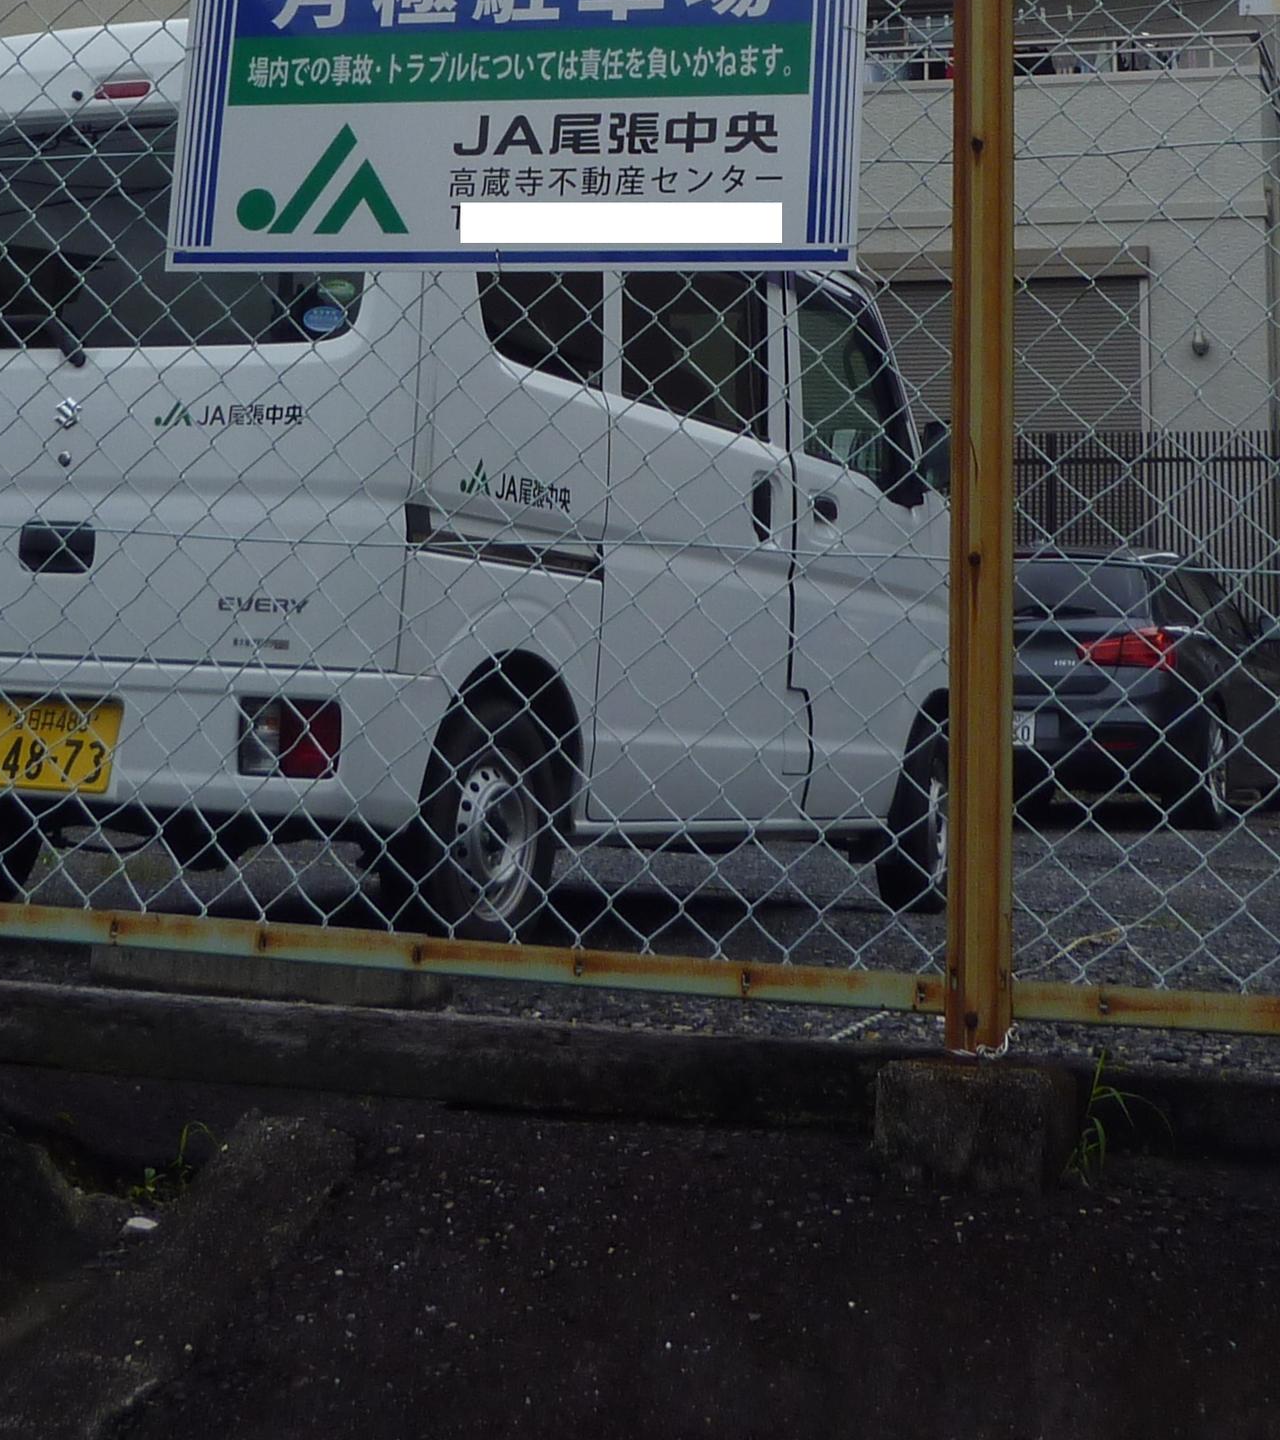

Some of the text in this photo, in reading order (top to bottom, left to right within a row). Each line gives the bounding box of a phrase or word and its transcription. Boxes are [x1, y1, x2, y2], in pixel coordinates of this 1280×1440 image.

[453, 110, 779, 156] JA尾張中央
[449, 163, 784, 198] 高蔵寺不動産センター
[197, 404, 303, 427] JA尾張中央
[218, 596, 308, 614] EVERY
